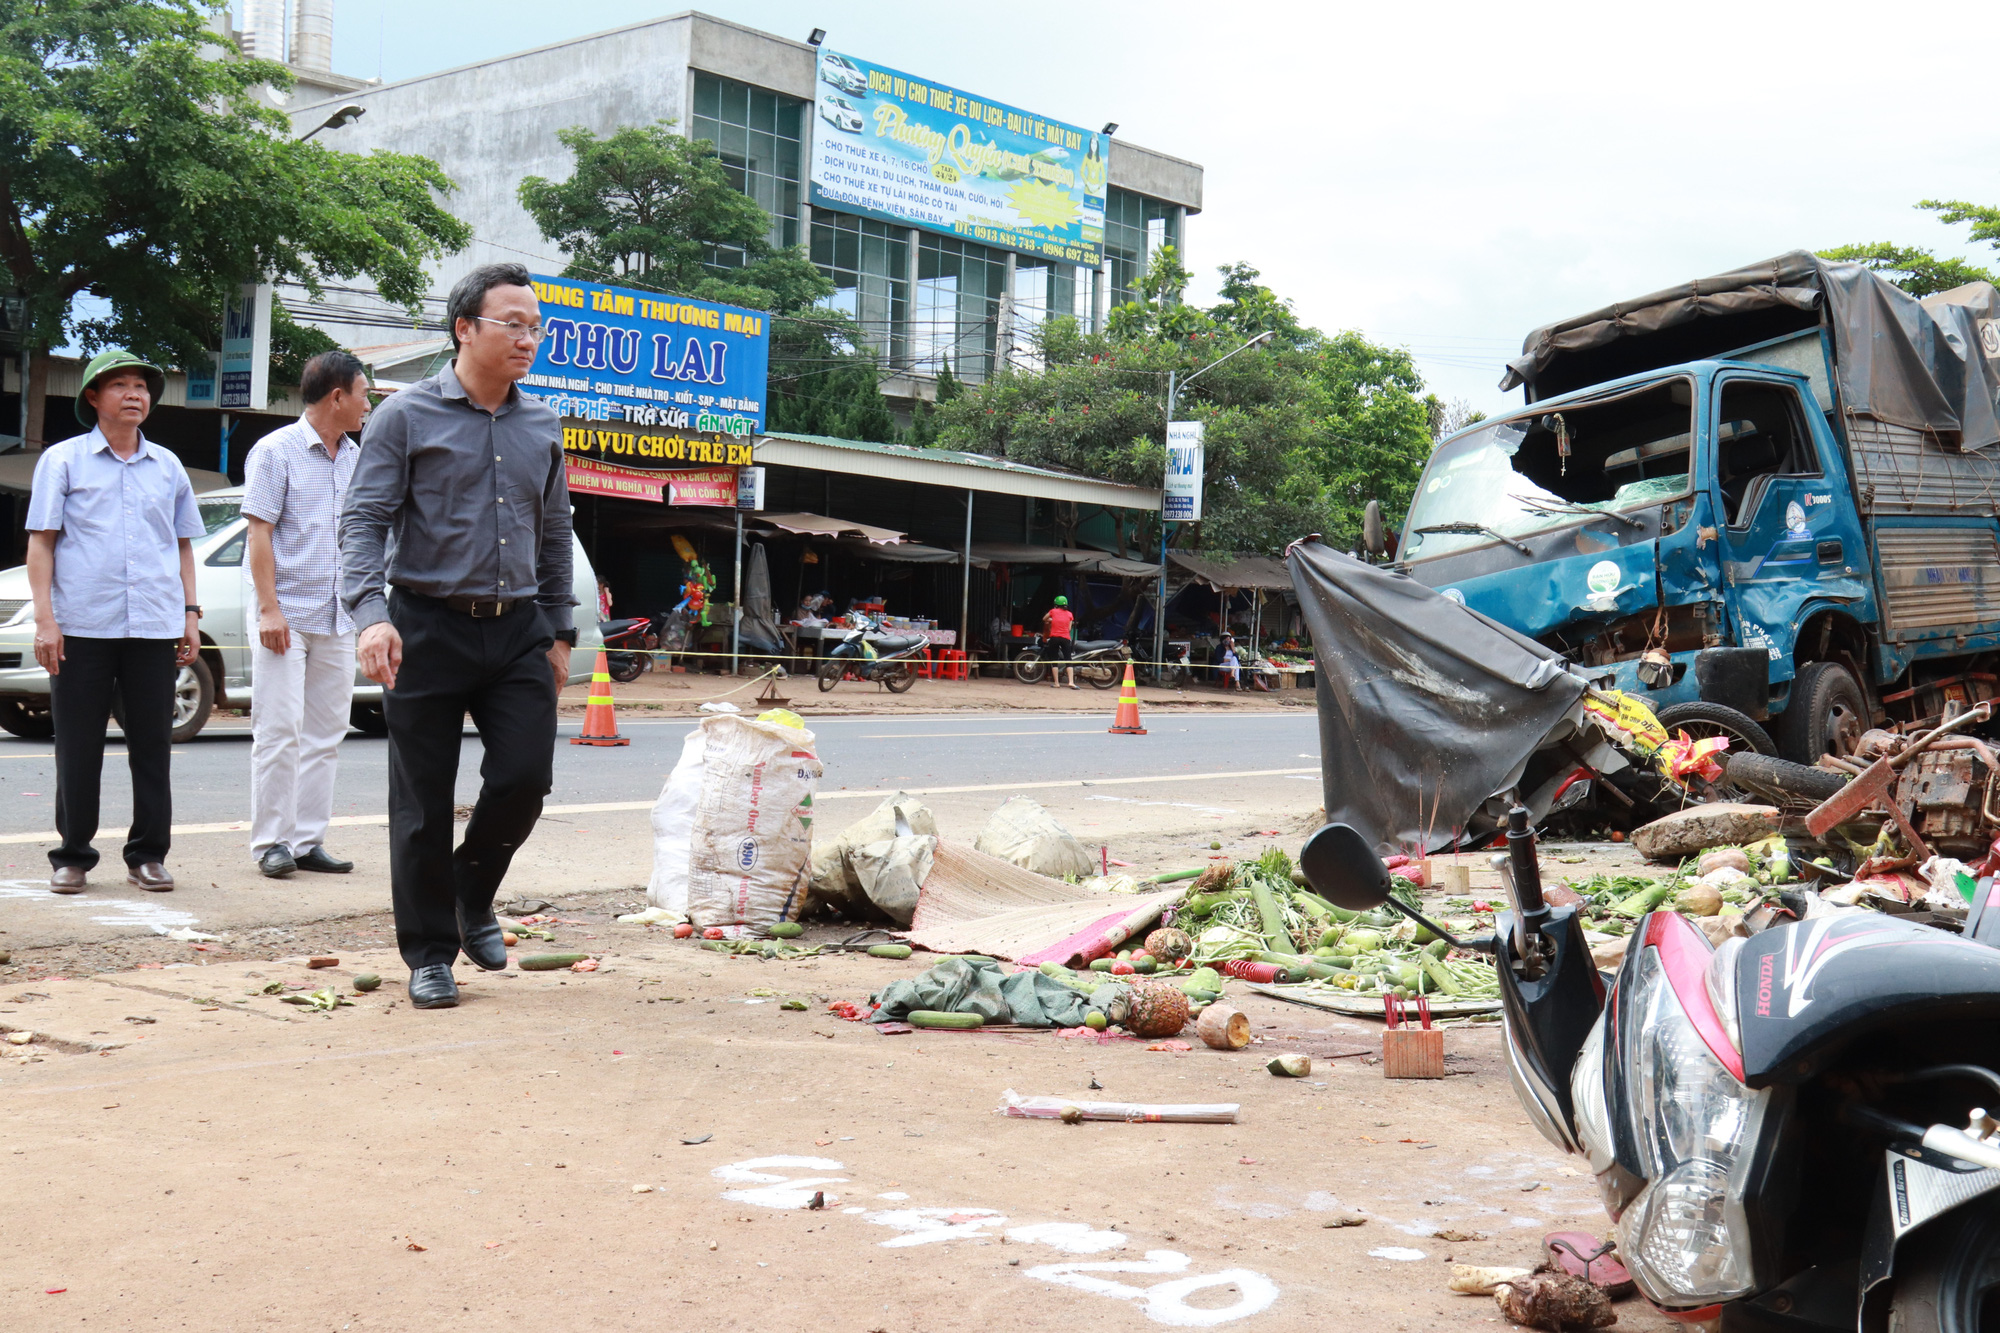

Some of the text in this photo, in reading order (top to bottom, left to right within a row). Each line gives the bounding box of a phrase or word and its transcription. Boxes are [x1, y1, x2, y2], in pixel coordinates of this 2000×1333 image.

[869, 69, 892, 95] DỊCH
[894, 77, 907, 102] VỤ
[908, 81, 928, 105] CHO
[930, 90, 954, 112] THUÊ
[955, 96, 968, 117] XE
[969, 100, 982, 121] DU
[1023, 115, 1033, 136] LÝ
[1034, 119, 1045, 140] VÉ
[1046, 123, 1065, 145] MÁY
[1066, 130, 1082, 151] BAY
[825, 139, 843, 152] CHO
[845, 144, 867, 159] THUÊ
[869, 151, 879, 162] XE
[901, 159, 910, 169] 16
[823, 171, 841, 184] CHO
[843, 176, 865, 190] THUÊ
[867, 182, 878, 193] XE
[880, 185, 891, 198] TỰ
[893, 187, 906, 200] LÁI
[908, 191, 930, 207] HOẶC
[931, 196, 943, 209] CÓ
[824, 155, 844, 169] DỊCH
[847, 161, 858, 174] VỤ
[883, 170, 894, 181] DU
[919, 179, 941, 193] THAM
[861, 195, 884, 211] BỆNH
[954, 220, 972, 236] ĐT:
[974, 225, 998, 242] 0913
[999, 231, 1017, 247] 842
[1018, 236, 1035, 251] 743
[1042, 242, 1064, 258] 0986
[1066, 247, 1082, 262] 697
[1083, 252, 1100, 265] 226
[531, 280, 762, 339] RUNG TÂM THƯƠNG MẠI
[545, 316, 728, 385] THU LAI
[549, 375, 566, 389] NHÀ
[567, 376, 589, 392] NGHỈ
[595, 382, 613, 394] CHO
[614, 384, 635, 397] THUÊ
[635, 385, 653, 400] NHÀ
[654, 389, 669, 404] TRỌ
[675, 389, 694, 405] KIỐT
[698, 395, 715, 408] SẠP
[720, 396, 737, 411] MẶT
[574, 397, 610, 422] PHÊ
[622, 403, 657, 426] TRÀ
[659, 406, 689, 430] SỮA
[697, 408, 721, 433] ĂN
[723, 413, 754, 439] VẶT
[562, 427, 753, 466] HU VUI CHƠI TRẺ EM
[569, 474, 599, 489] NHIỆM
[601, 477, 614, 490] VÀ
[616, 480, 642, 494] NGHĨA
[645, 484, 657, 498] VỤ
[698, 486, 720, 499] CÔNG
[747, 761, 766, 832] Number One
[741, 841, 755, 866] 990
[1757, 955, 1774, 1017] HONDA
